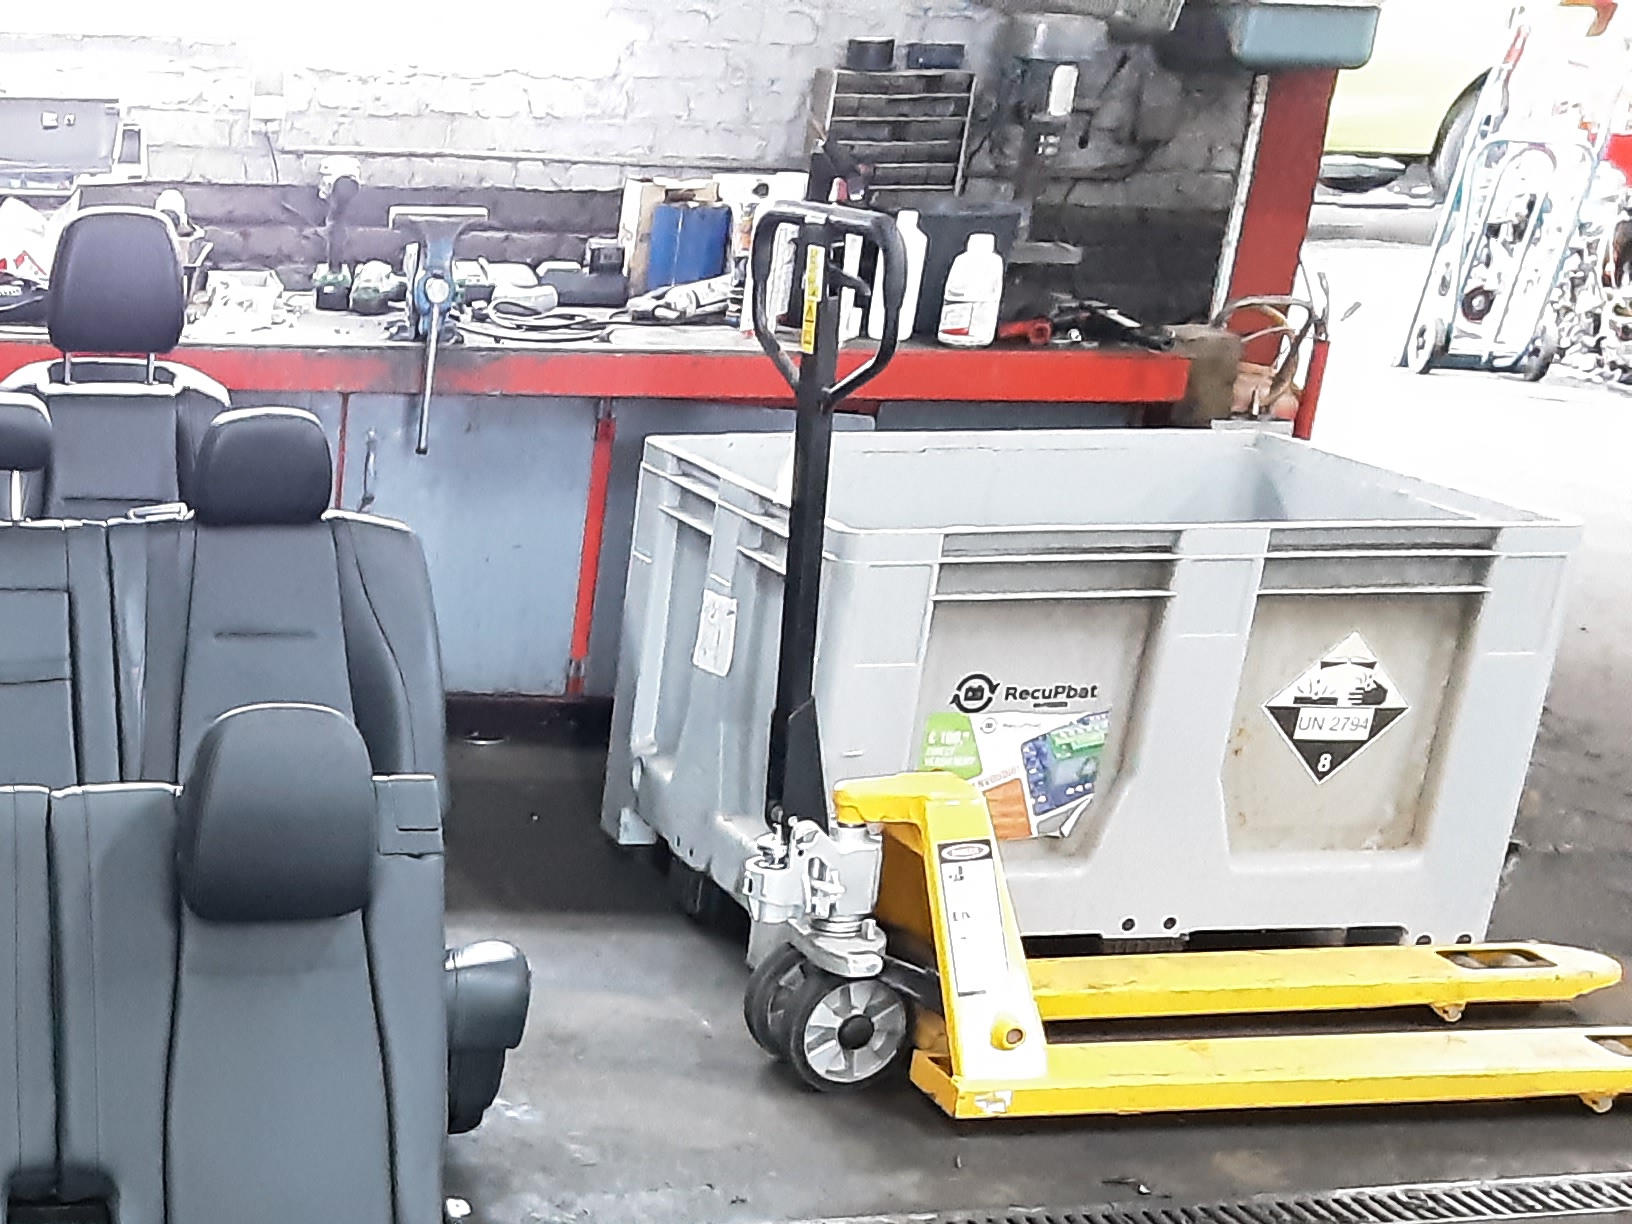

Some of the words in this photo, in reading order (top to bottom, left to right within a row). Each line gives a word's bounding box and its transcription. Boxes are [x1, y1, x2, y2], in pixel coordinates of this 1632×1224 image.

[1004, 684, 1098, 701] RecuPbat
[1298, 717, 1325, 731] UN
[1329, 717, 1369, 731] 2794
[1317, 753, 1332, 772] 8
